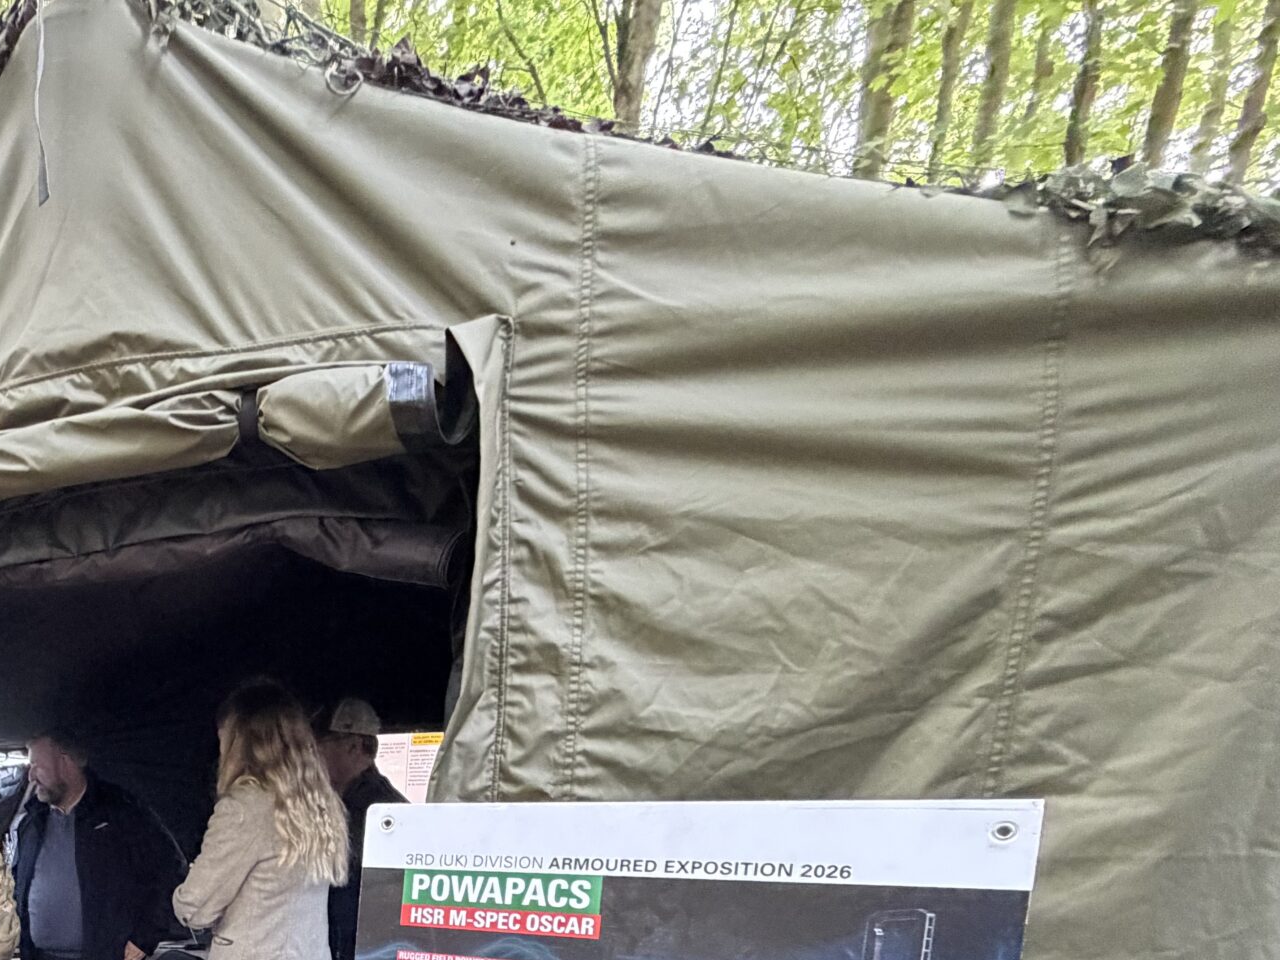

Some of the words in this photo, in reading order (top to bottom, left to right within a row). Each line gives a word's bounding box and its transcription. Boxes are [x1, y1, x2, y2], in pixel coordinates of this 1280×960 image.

[405, 853, 434, 865] 3RD
[438, 854, 467, 866] (UK)
[472, 854, 543, 869] DIVISION
[547, 856, 657, 872] ARMOURED
[663, 859, 793, 877] EXPOSITION
[799, 863, 851, 879] 2026
[410, 872, 591, 909] POWAPACS
[409, 906, 445, 925] HSR
[448, 909, 521, 930] M-SPEC
[525, 913, 594, 935] OSCAR
